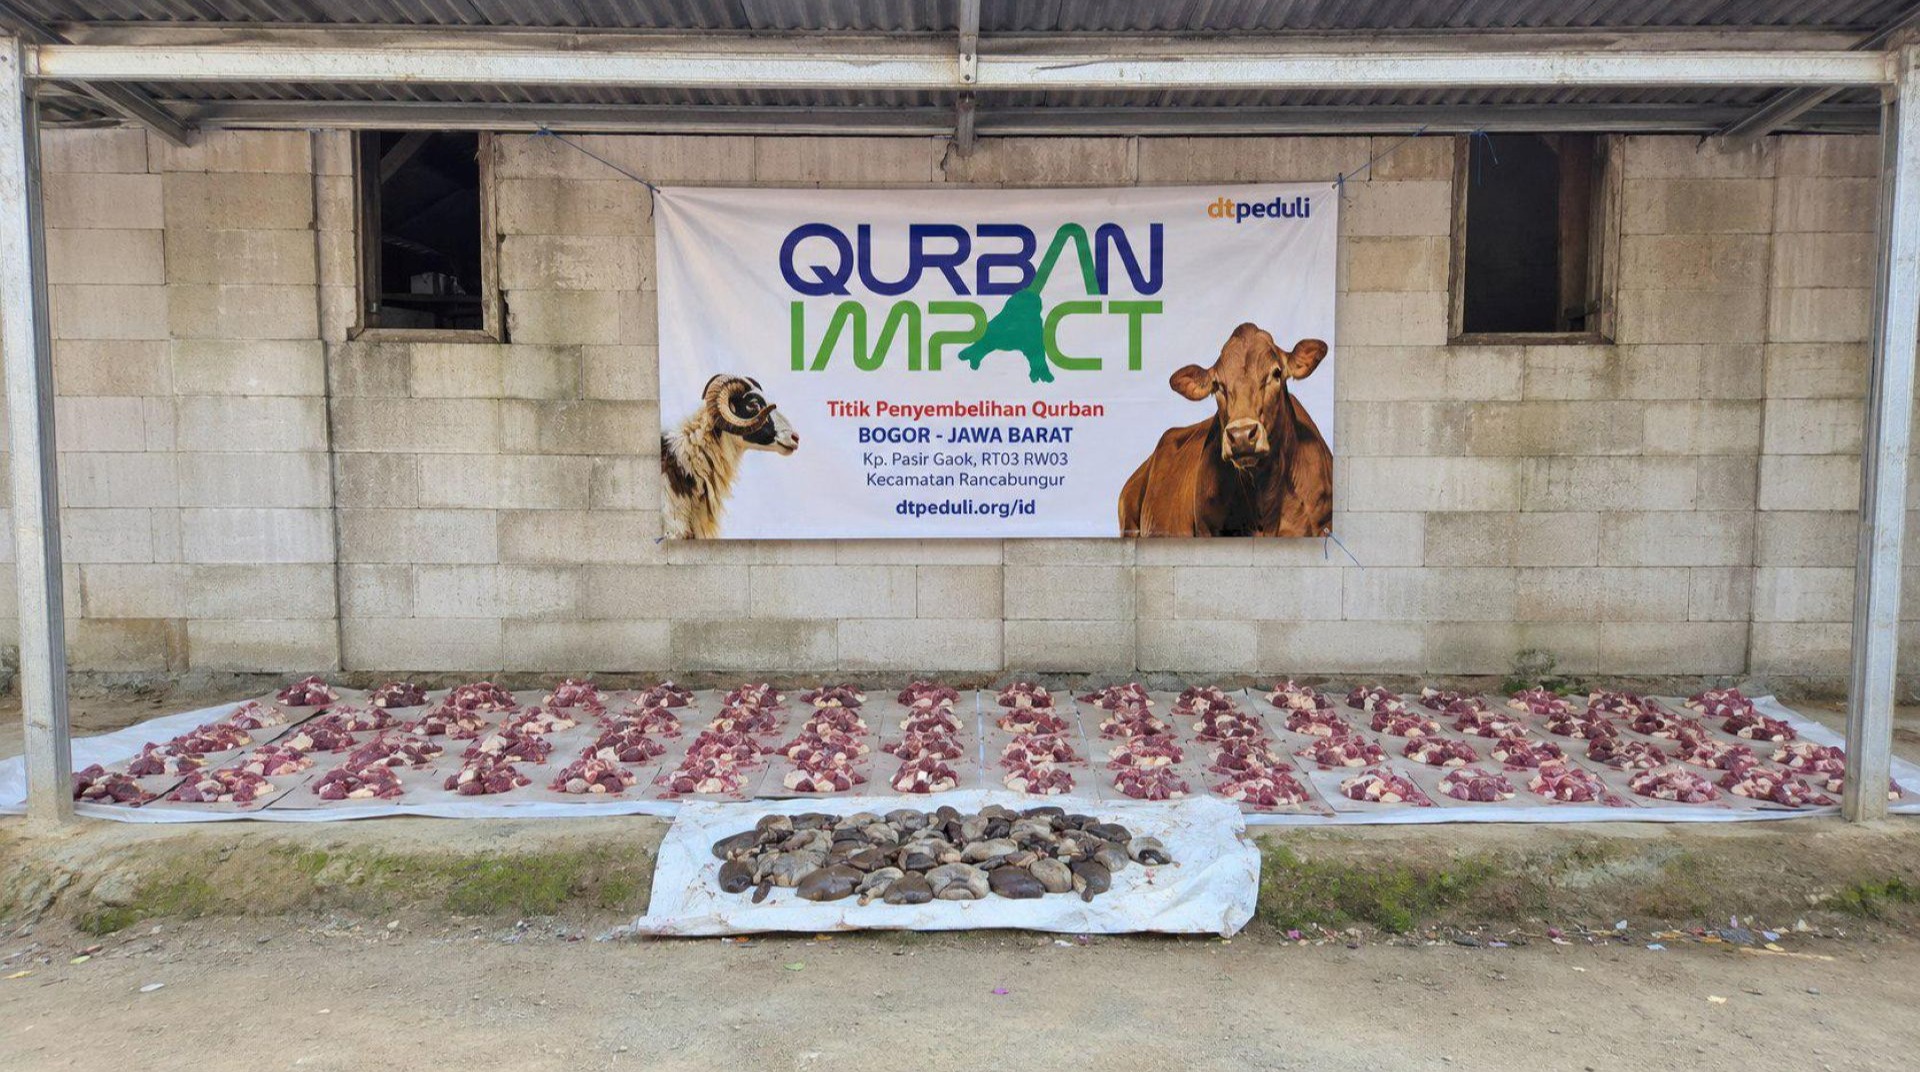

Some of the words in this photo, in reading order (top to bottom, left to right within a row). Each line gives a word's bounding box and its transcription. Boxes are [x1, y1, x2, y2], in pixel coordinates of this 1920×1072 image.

[1208, 197, 1310, 223] dtpeduli
[779, 222, 1164, 296] QURBAN
[791, 300, 1163, 379] IMPACT
[827, 400, 871, 418] Titik
[876, 400, 1026, 421] Penyembelihan
[1032, 400, 1105, 419] Qurban
[859, 427, 931, 443] BOGOR
[948, 427, 1003, 443] JAWA
[1008, 427, 1074, 443] BARAT
[863, 452, 888, 469] Kp.
[892, 451, 929, 466] Pasir
[933, 451, 977, 468] Gaok,
[982, 452, 1019, 466] RT03
[1024, 452, 1069, 466] RW03
[867, 472, 955, 487] Kecamatan
[959, 472, 1066, 489] Rancabungur
[896, 499, 1036, 518] dtpeduli.org/id
